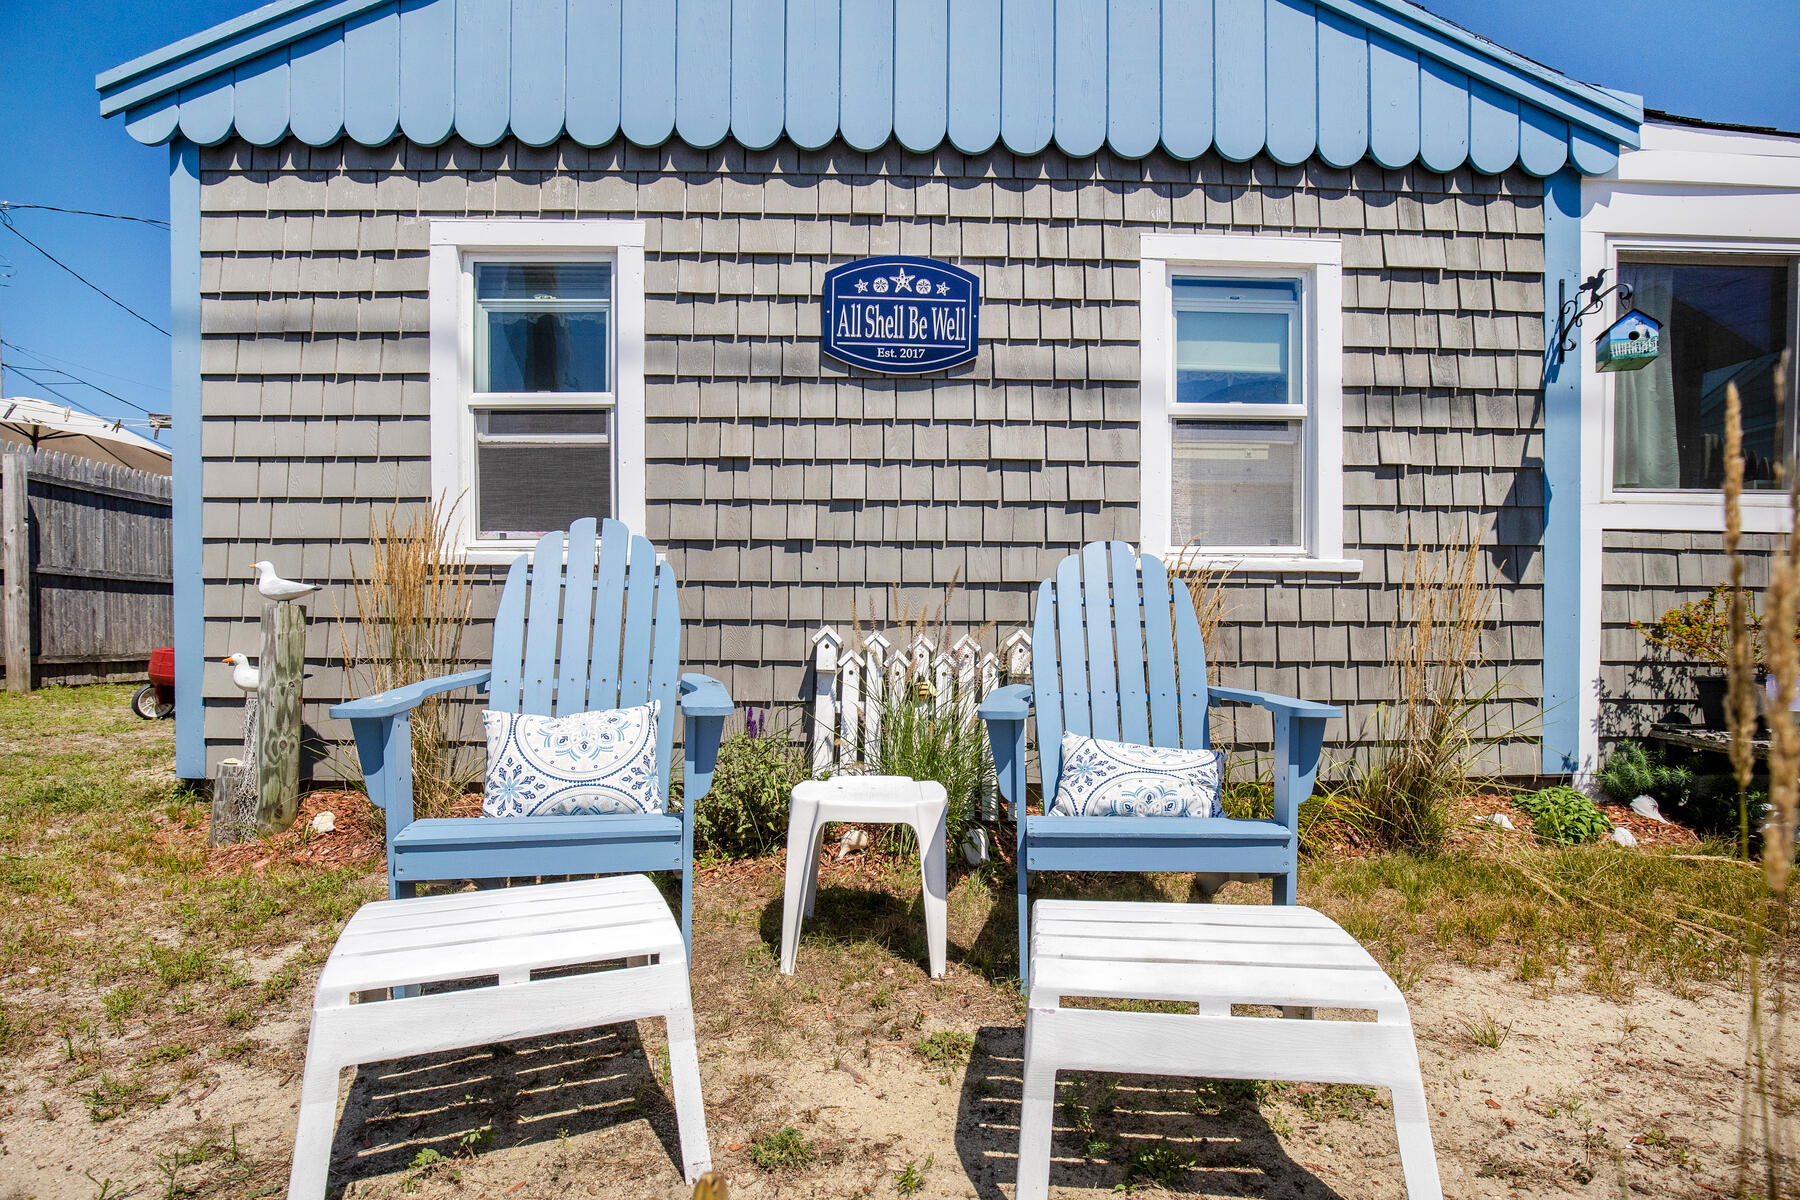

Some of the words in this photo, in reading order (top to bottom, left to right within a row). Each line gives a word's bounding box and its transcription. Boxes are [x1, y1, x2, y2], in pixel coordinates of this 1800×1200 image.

[836, 303, 862, 338] All
[865, 303, 905, 339] Shell
[908, 306, 928, 340] Be
[931, 307, 967, 341] Well
[877, 347, 898, 358] Est.
[900, 348, 926, 359] 2017
